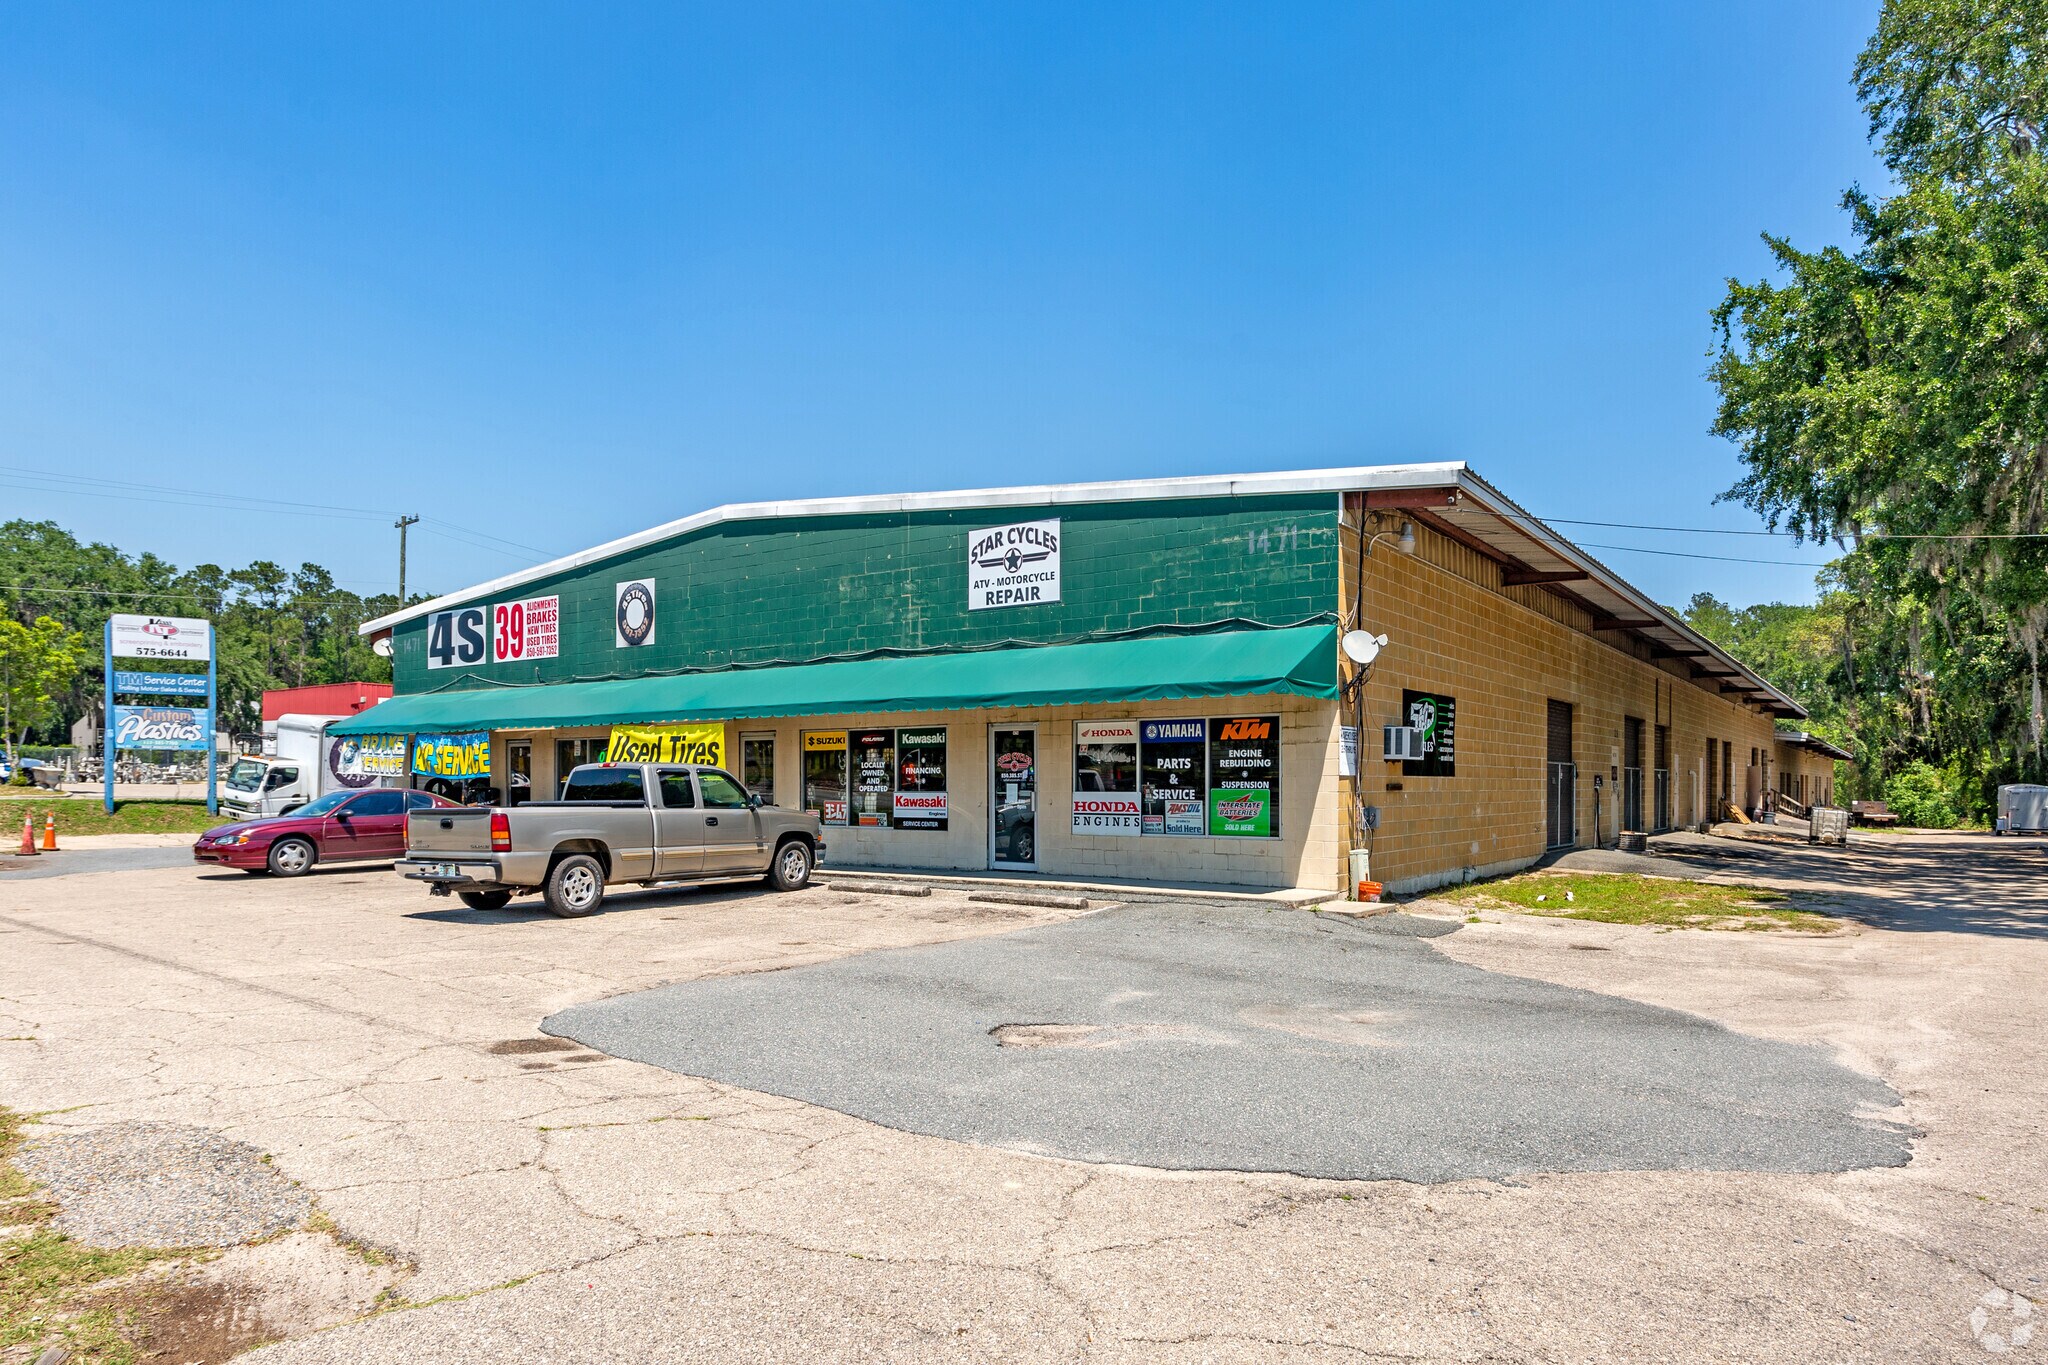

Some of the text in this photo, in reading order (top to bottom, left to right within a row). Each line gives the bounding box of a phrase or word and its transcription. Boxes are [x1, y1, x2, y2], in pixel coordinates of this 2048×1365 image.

[971, 527, 1058, 565] STAR CYCLES
[1248, 524, 1298, 555] 1471
[974, 579, 990, 589] ATV
[996, 571, 1055, 587] MOTORCYCLE
[985, 586, 1041, 606] REPAIR
[526, 598, 558, 612] ALIGNMENTS
[526, 609, 558, 625] BRAKES
[527, 623, 557, 636] NEW TIRES
[429, 609, 485, 666] 4S
[526, 634, 558, 647] USED TIRES
[135, 647, 188, 657] 575-6644
[403, 637, 420, 654] 1471
[116, 672, 206, 687] TM Service Center
[117, 684, 139, 692] Trolling
[142, 708, 193, 721] Custom
[116, 714, 203, 744] Plastics
[1091, 729, 1134, 737] HONDA
[1158, 724, 1203, 738] YAMAHA
[1220, 718, 1270, 740] KTM
[361, 734, 405, 755] BRAKE
[816, 737, 846, 745] SUZUKI
[901, 732, 946, 745] Kawasaki
[610, 735, 662, 763] Used
[669, 735, 720, 766] Tires
[1228, 749, 1263, 758] ENGINE
[434, 741, 491, 776] SERVICE
[861, 761, 885, 769] LOCALLY
[1157, 758, 1191, 769] PARTS
[1220, 759, 1271, 768] REBUILDING
[866, 777, 880, 785] AND
[1169, 774, 1178, 785] &
[1221, 781, 1270, 789] SUSPENSION
[1152, 789, 1196, 800] SERVICE
[895, 795, 947, 808] Kawasaki
[1073, 801, 1140, 813] HONDA
[1167, 804, 1200, 814] AMSOIL
[1073, 816, 1140, 827] ENGINES
[1166, 824, 1202, 833] Sold Here
